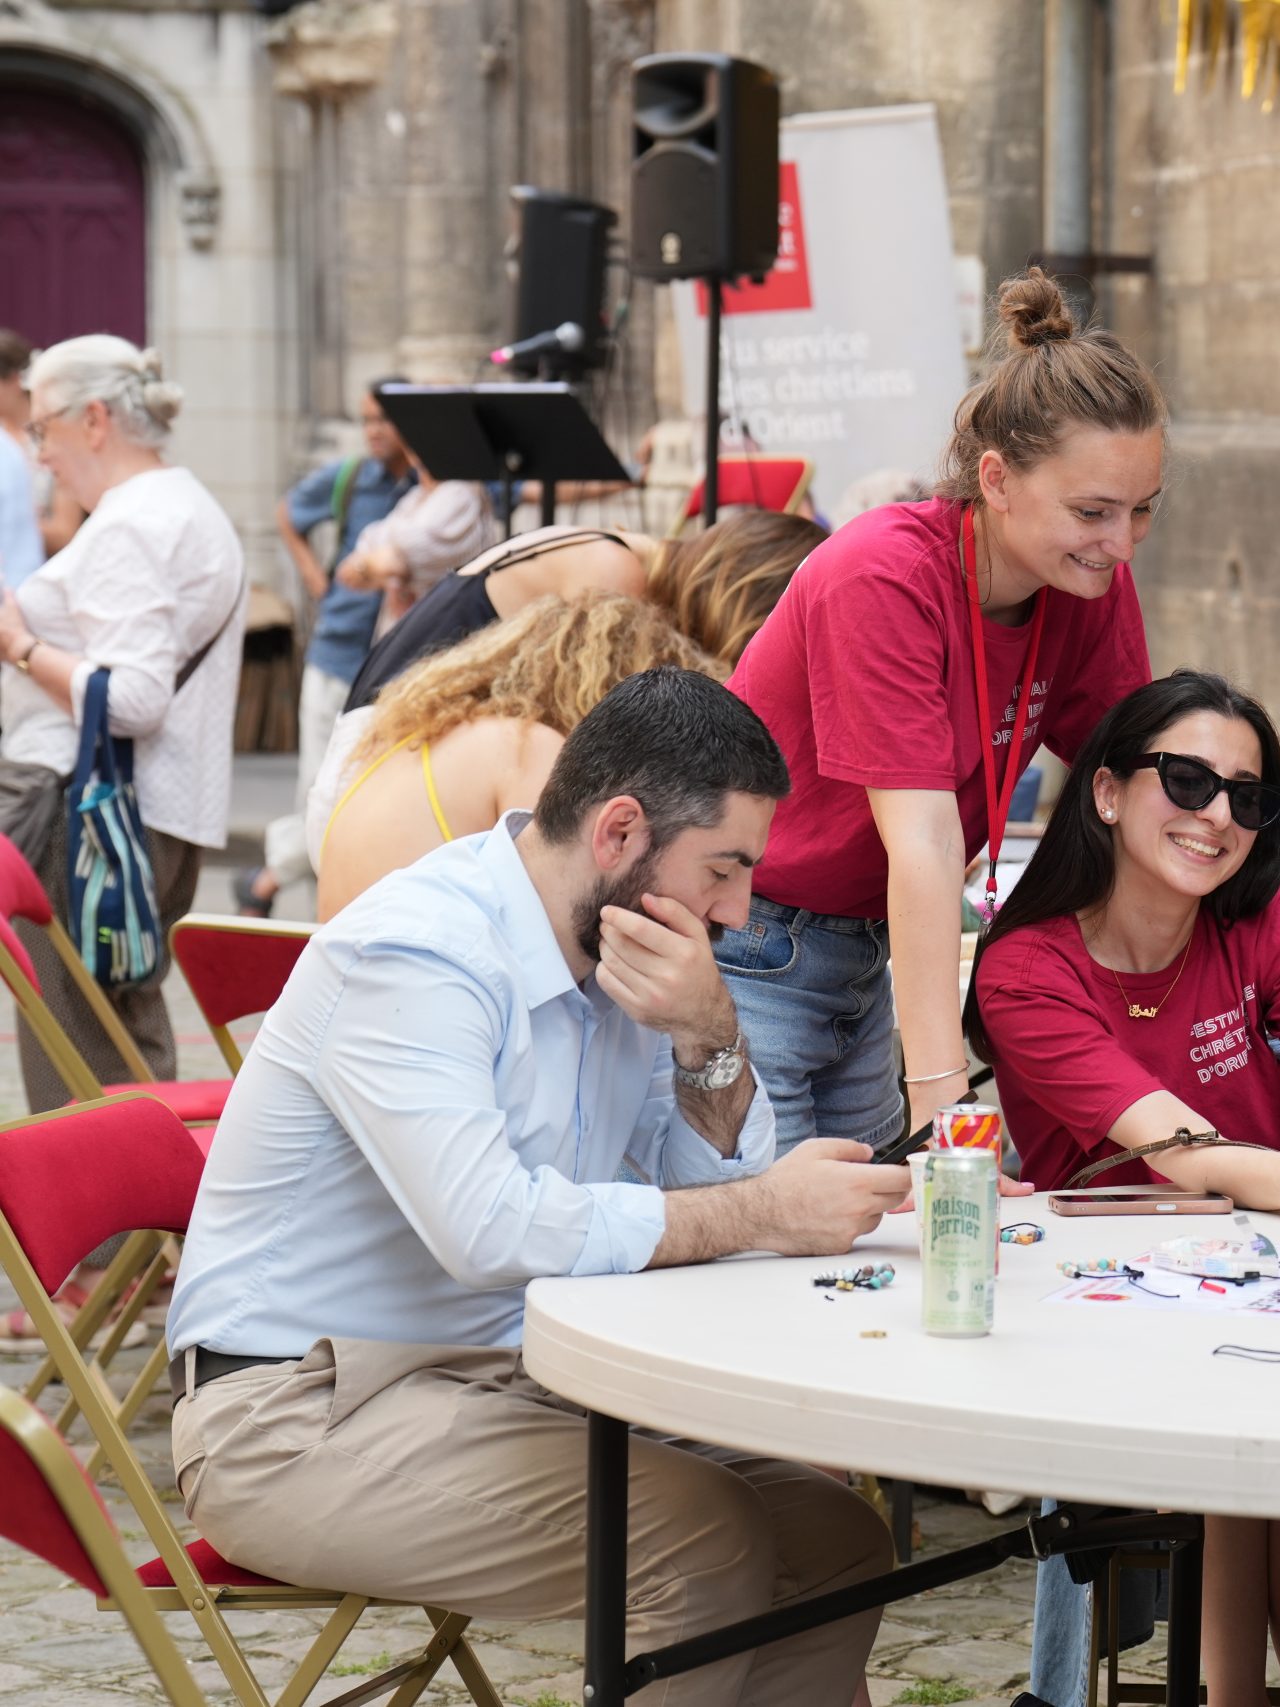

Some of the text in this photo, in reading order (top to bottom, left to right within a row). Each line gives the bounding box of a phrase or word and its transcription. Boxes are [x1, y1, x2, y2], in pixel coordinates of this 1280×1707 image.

[761, 325, 869, 366] service
[774, 363, 917, 404] chrétiens
[932, 1196, 981, 1222] Maison
